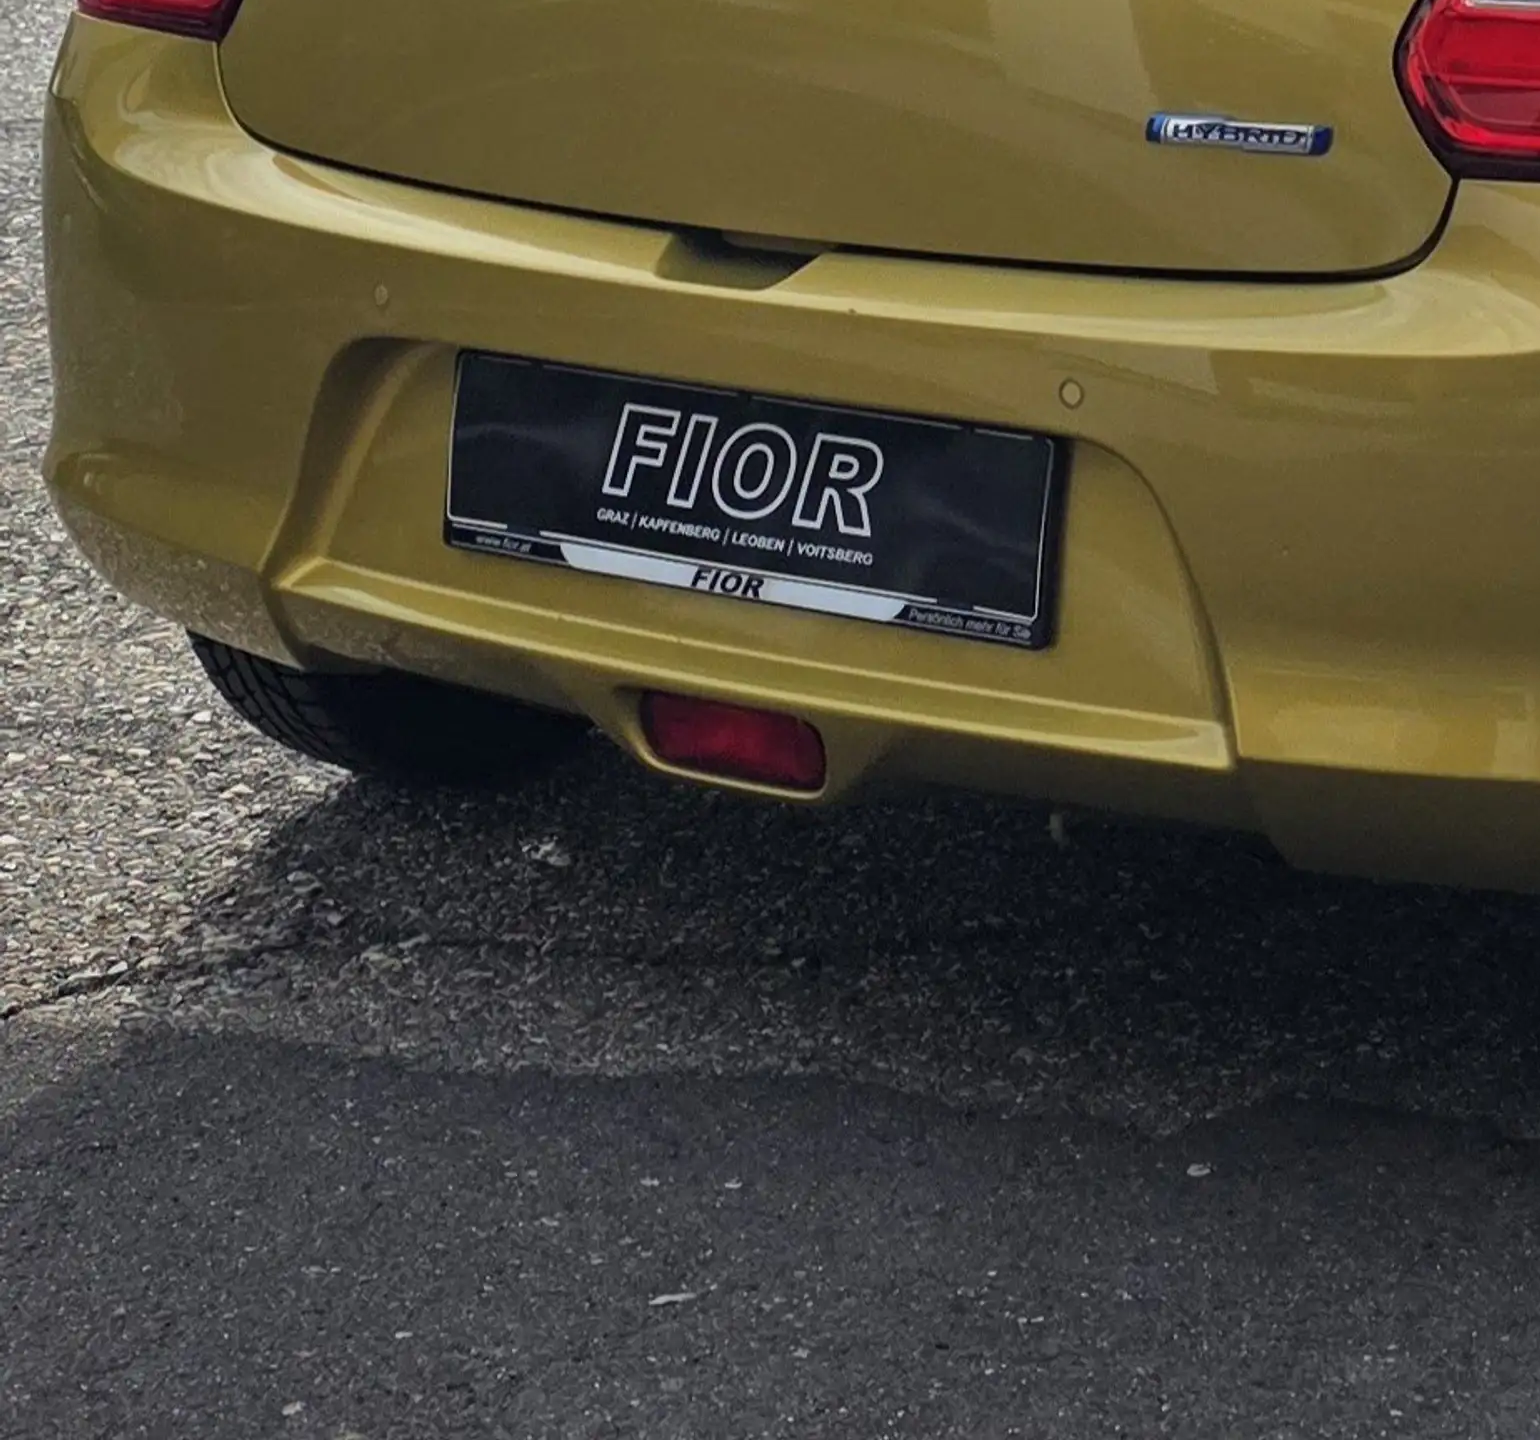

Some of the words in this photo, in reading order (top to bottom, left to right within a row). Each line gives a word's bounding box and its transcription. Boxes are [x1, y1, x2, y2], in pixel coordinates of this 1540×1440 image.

[1169, 120, 1309, 149] HYBRID
[601, 402, 885, 537] FIOR
[596, 508, 630, 527] GRAZ
[637, 514, 721, 542] KAPFENBERG
[731, 531, 786, 553] LEOBEN
[796, 541, 874, 566] VOITSBERG
[690, 566, 766, 599] FIOR
